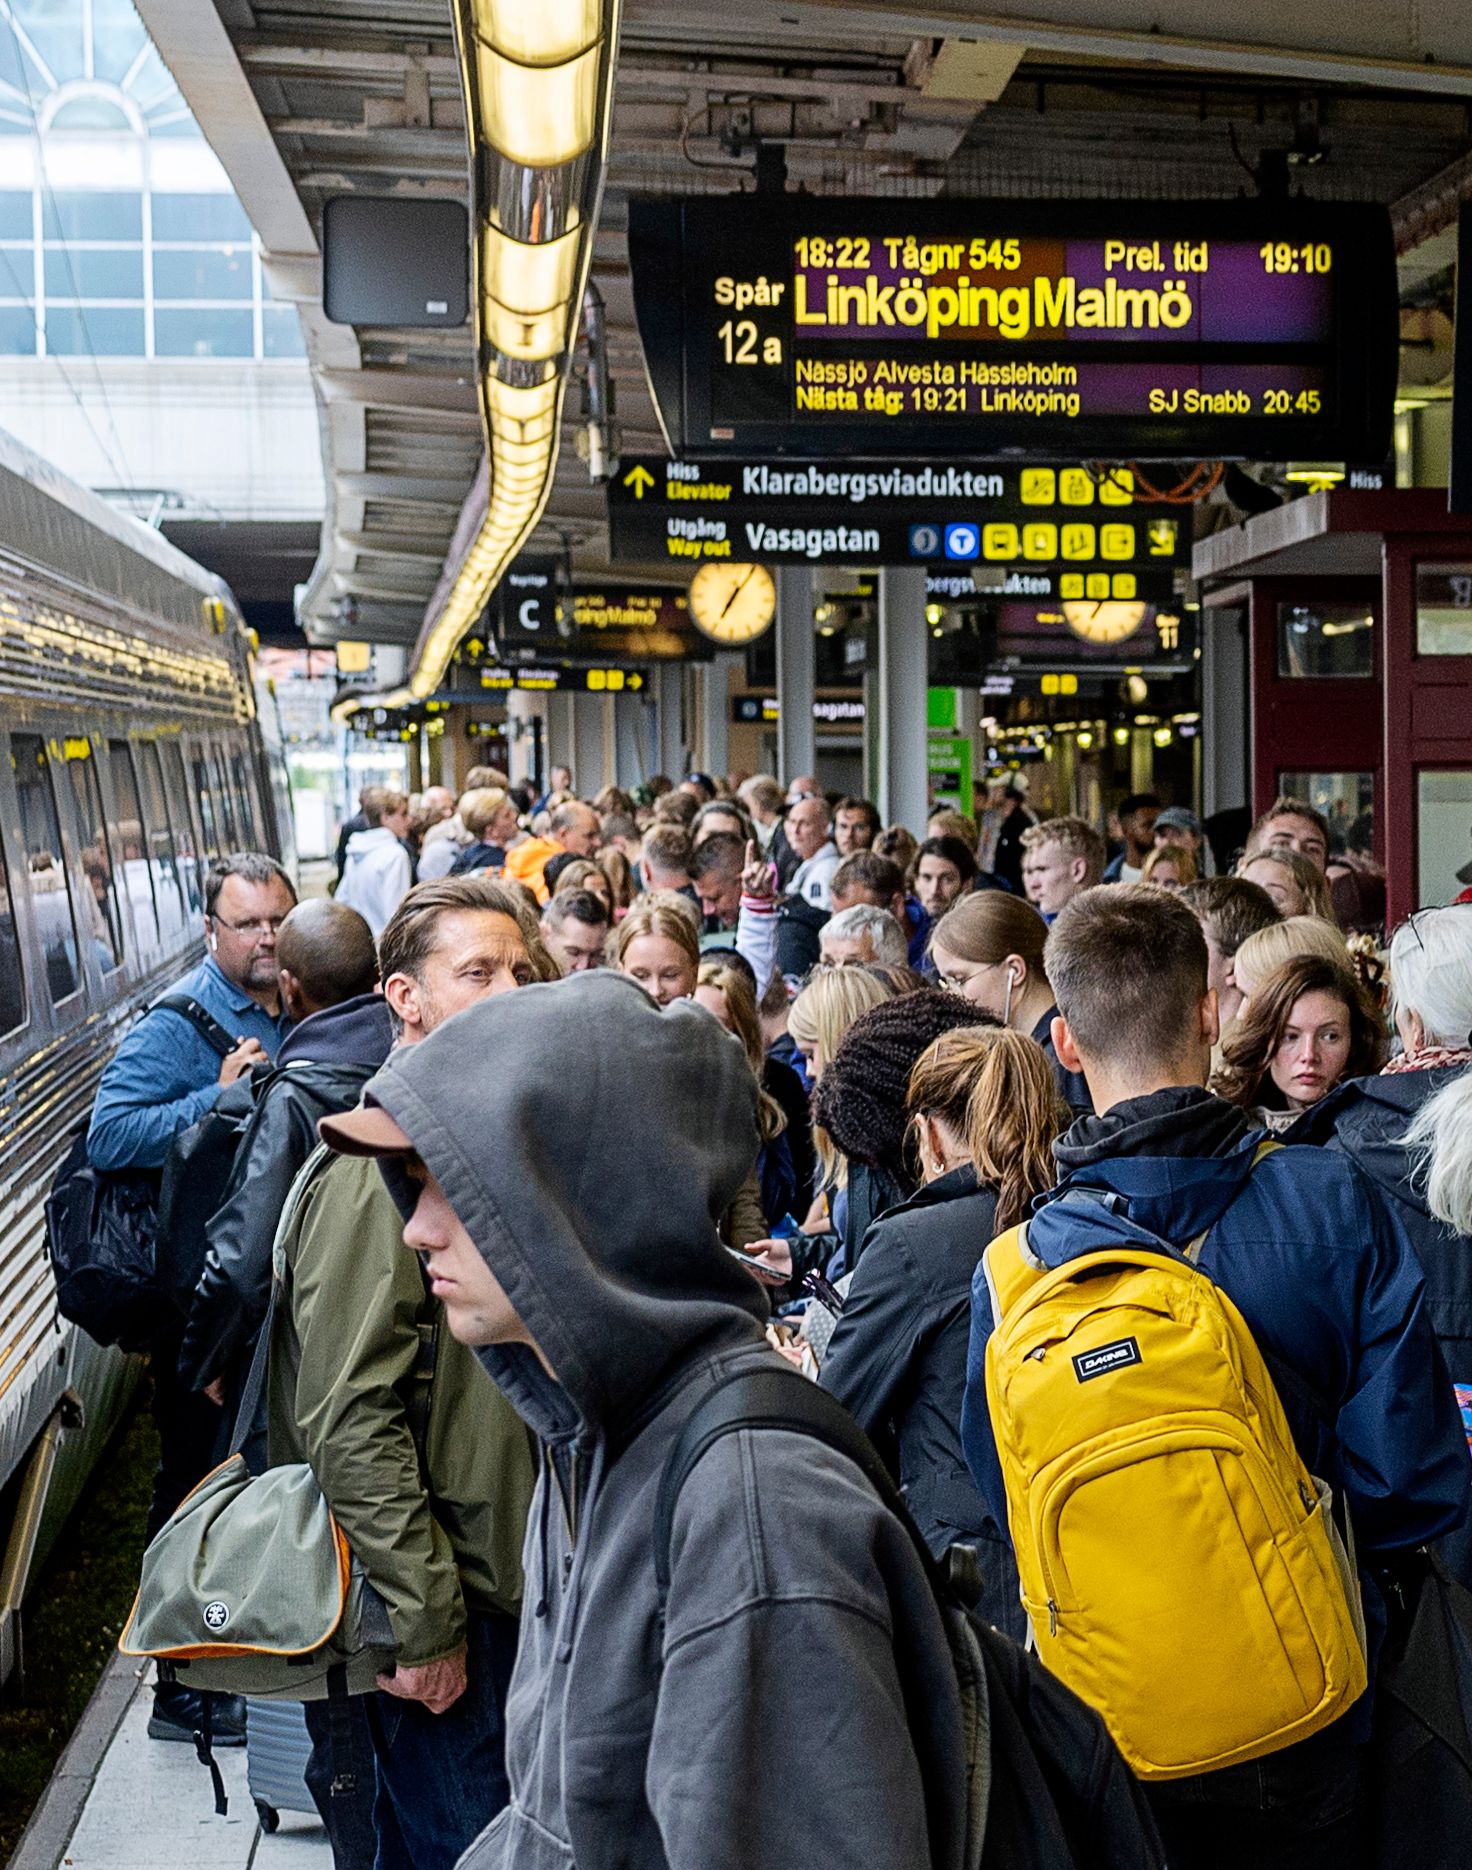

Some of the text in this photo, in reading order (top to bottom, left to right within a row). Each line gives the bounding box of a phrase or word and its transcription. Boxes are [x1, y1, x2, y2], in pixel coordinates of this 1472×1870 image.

[795, 234, 1332, 275] 18:22 Tågnr 545 Prel. tid 19:10
[714, 276, 785, 311] Spår
[795, 360, 1077, 388] Nässjö Alvesta Hässleholm
[795, 385, 1321, 417] Nästa tåg: 19:21 Linköping SJ Snabb 20:45
[666, 462, 700, 481] Hiss
[743, 465, 1004, 502] Klarabergsviadukten
[1350, 470, 1383, 489] Hiss
[666, 480, 732, 500] Elevator
[666, 517, 727, 541] Utgång
[745, 522, 880, 558] Vasagatan
[667, 537, 732, 560] Way out
[519, 599, 541, 631] C
